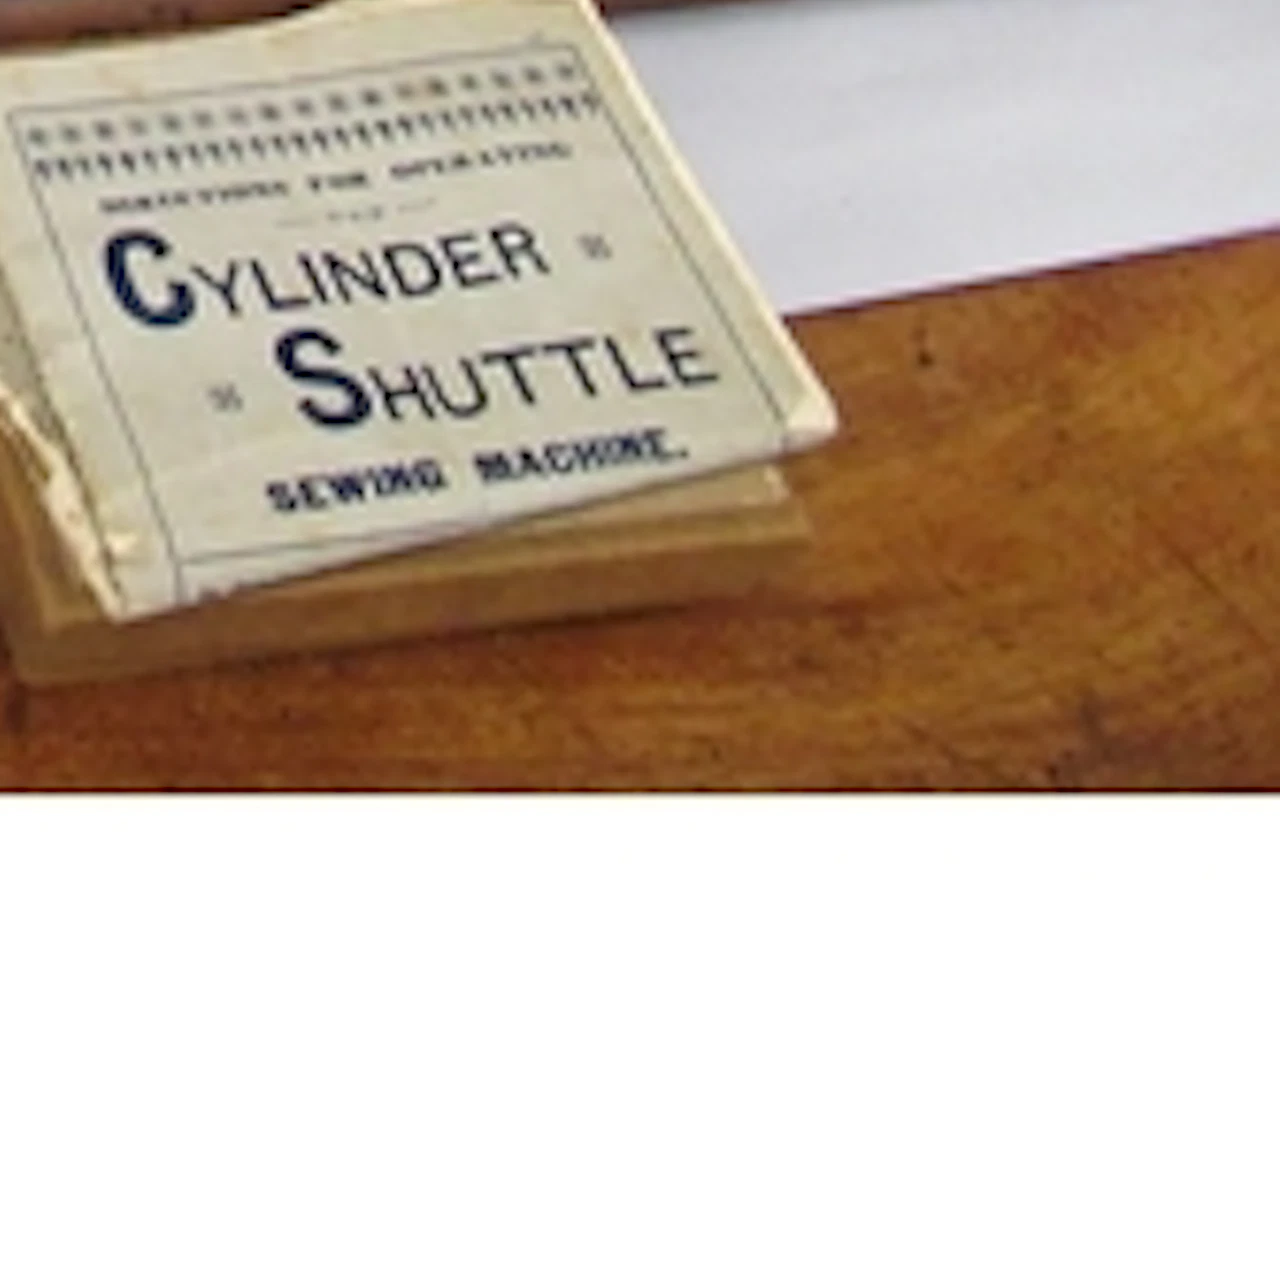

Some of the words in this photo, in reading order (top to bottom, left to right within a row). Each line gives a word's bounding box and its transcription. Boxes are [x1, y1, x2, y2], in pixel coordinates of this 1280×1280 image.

[103, 221, 550, 327] CYLINDER
[274, 326, 720, 427] SHUTTLE
[265, 458, 447, 513] SEWING
[473, 428, 690, 486] MACHINE.
